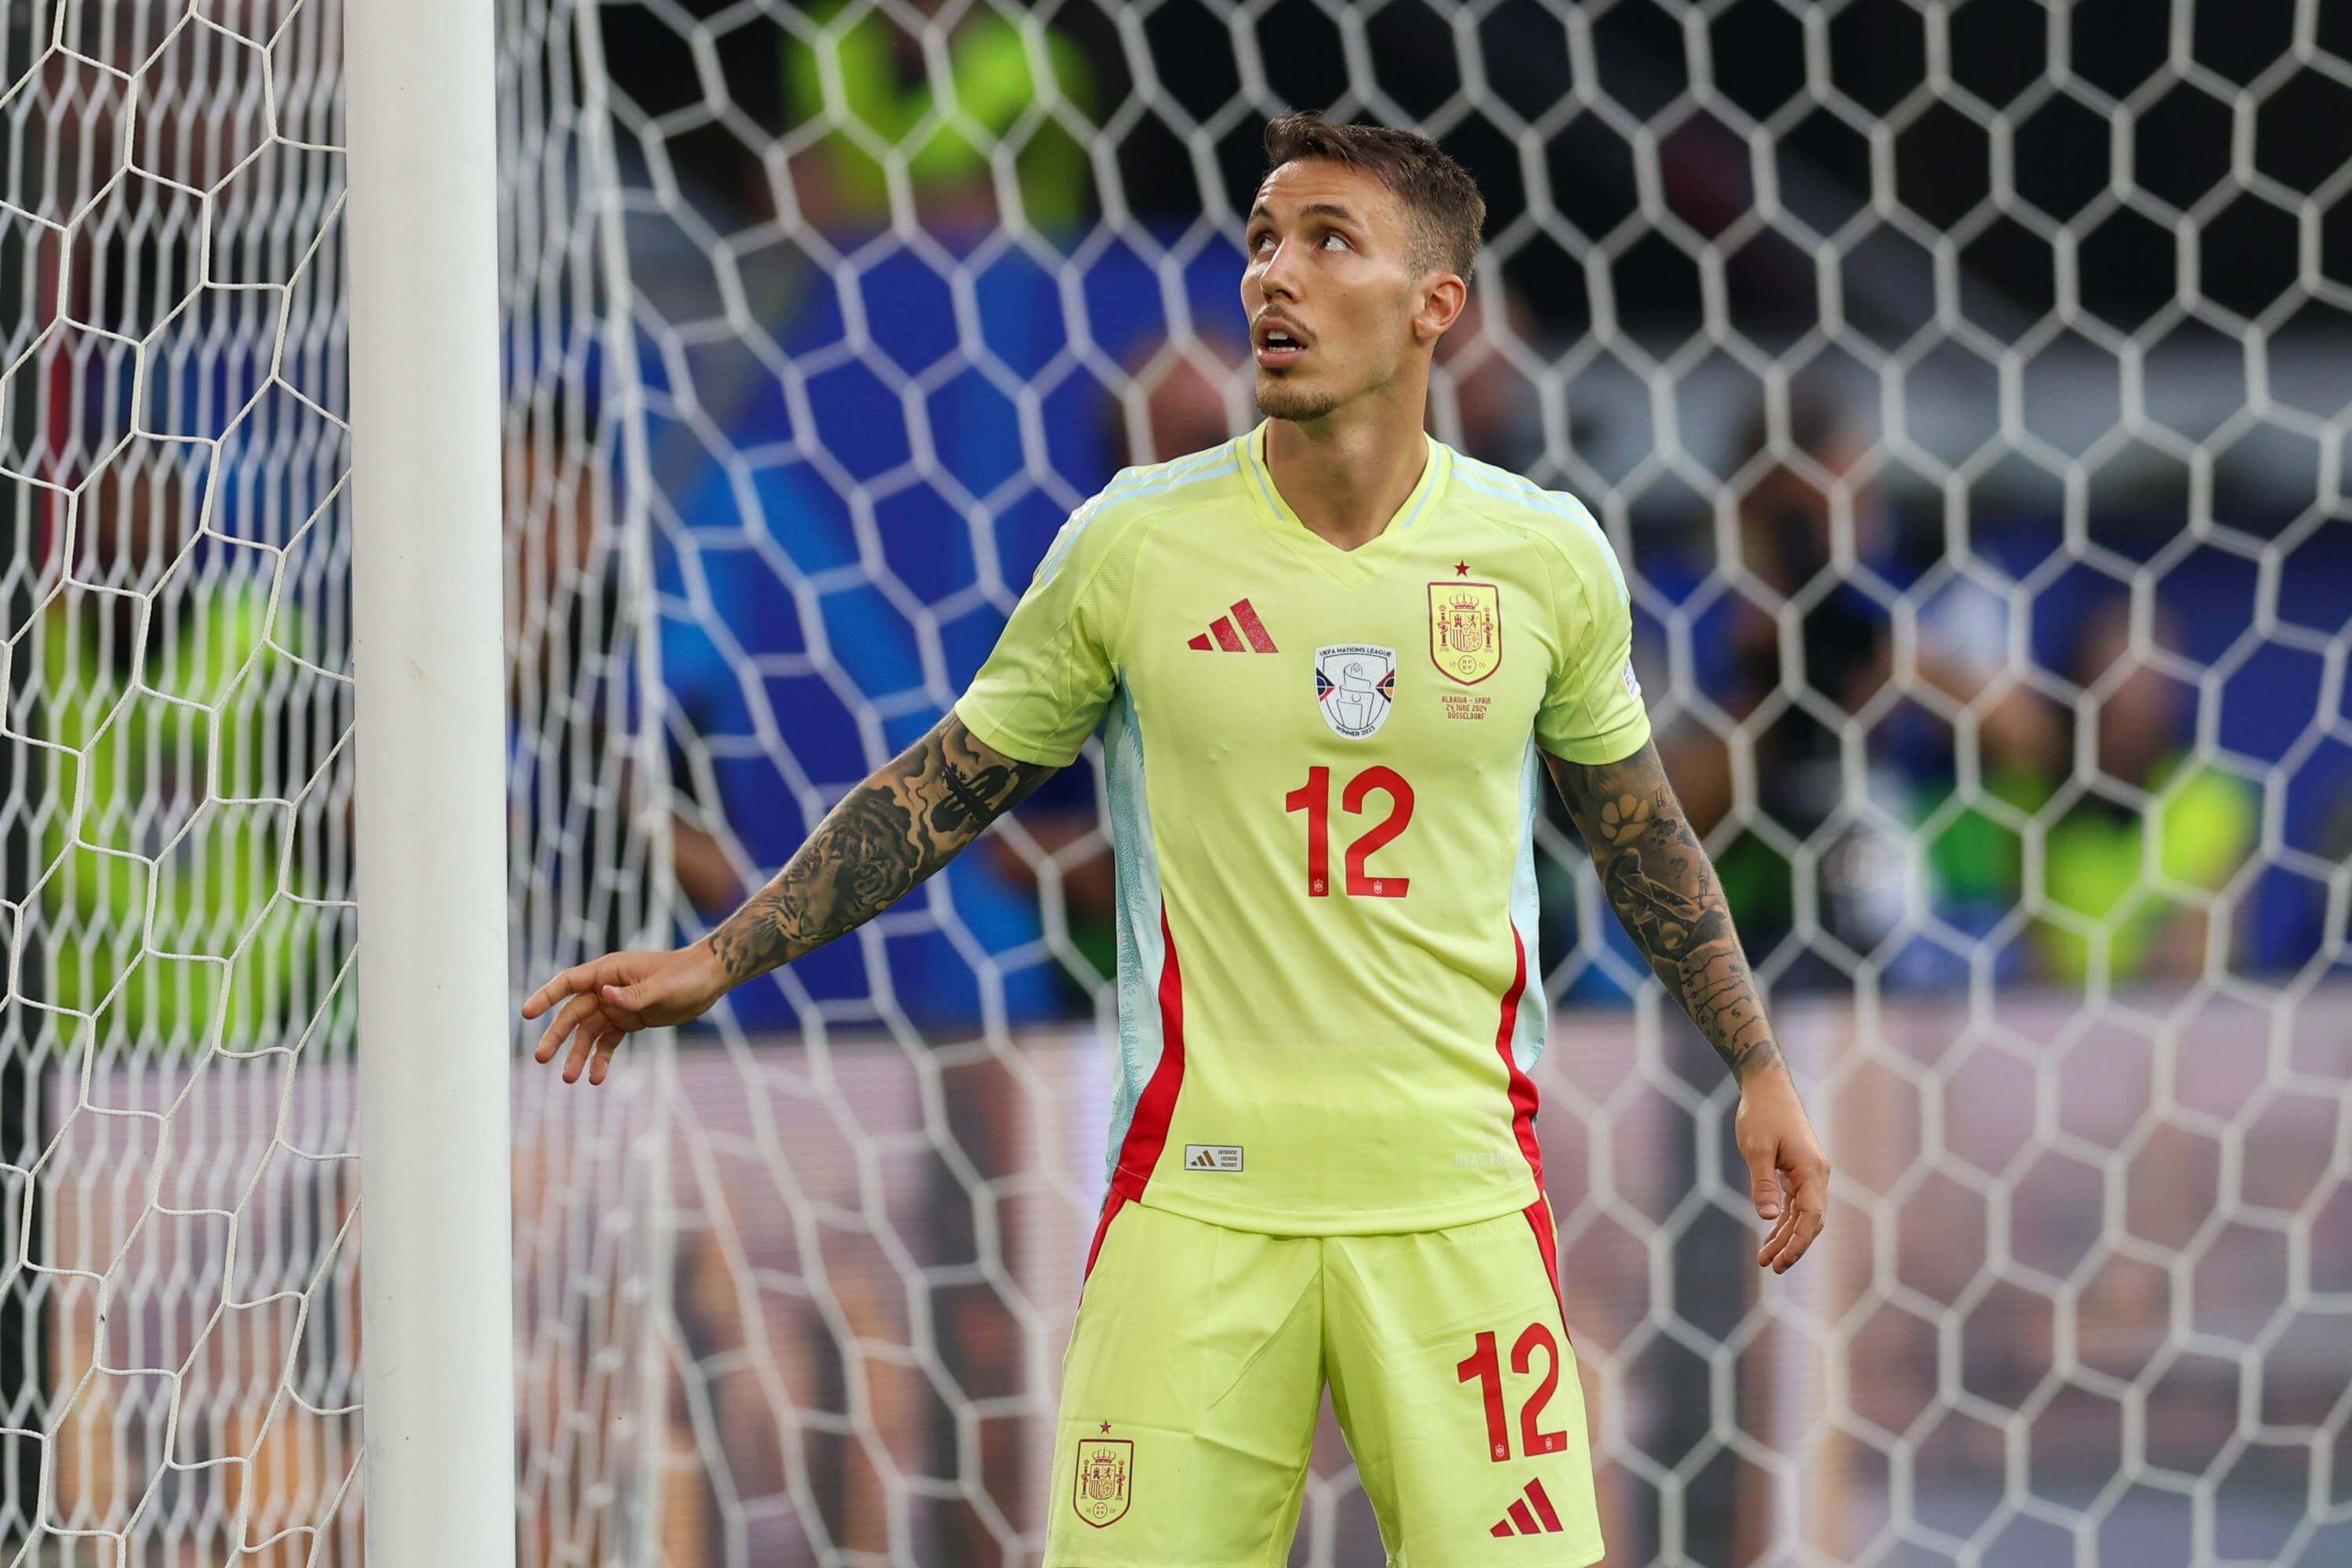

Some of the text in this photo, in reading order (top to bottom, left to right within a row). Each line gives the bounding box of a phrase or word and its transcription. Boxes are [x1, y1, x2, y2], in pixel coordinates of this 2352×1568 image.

[1367, 648, 1392, 657] LEAGUE
[1336, 724, 1375, 736] WINNER 2023
[1286, 765, 1414, 898] 12
[1457, 1322, 1567, 1463] 12
